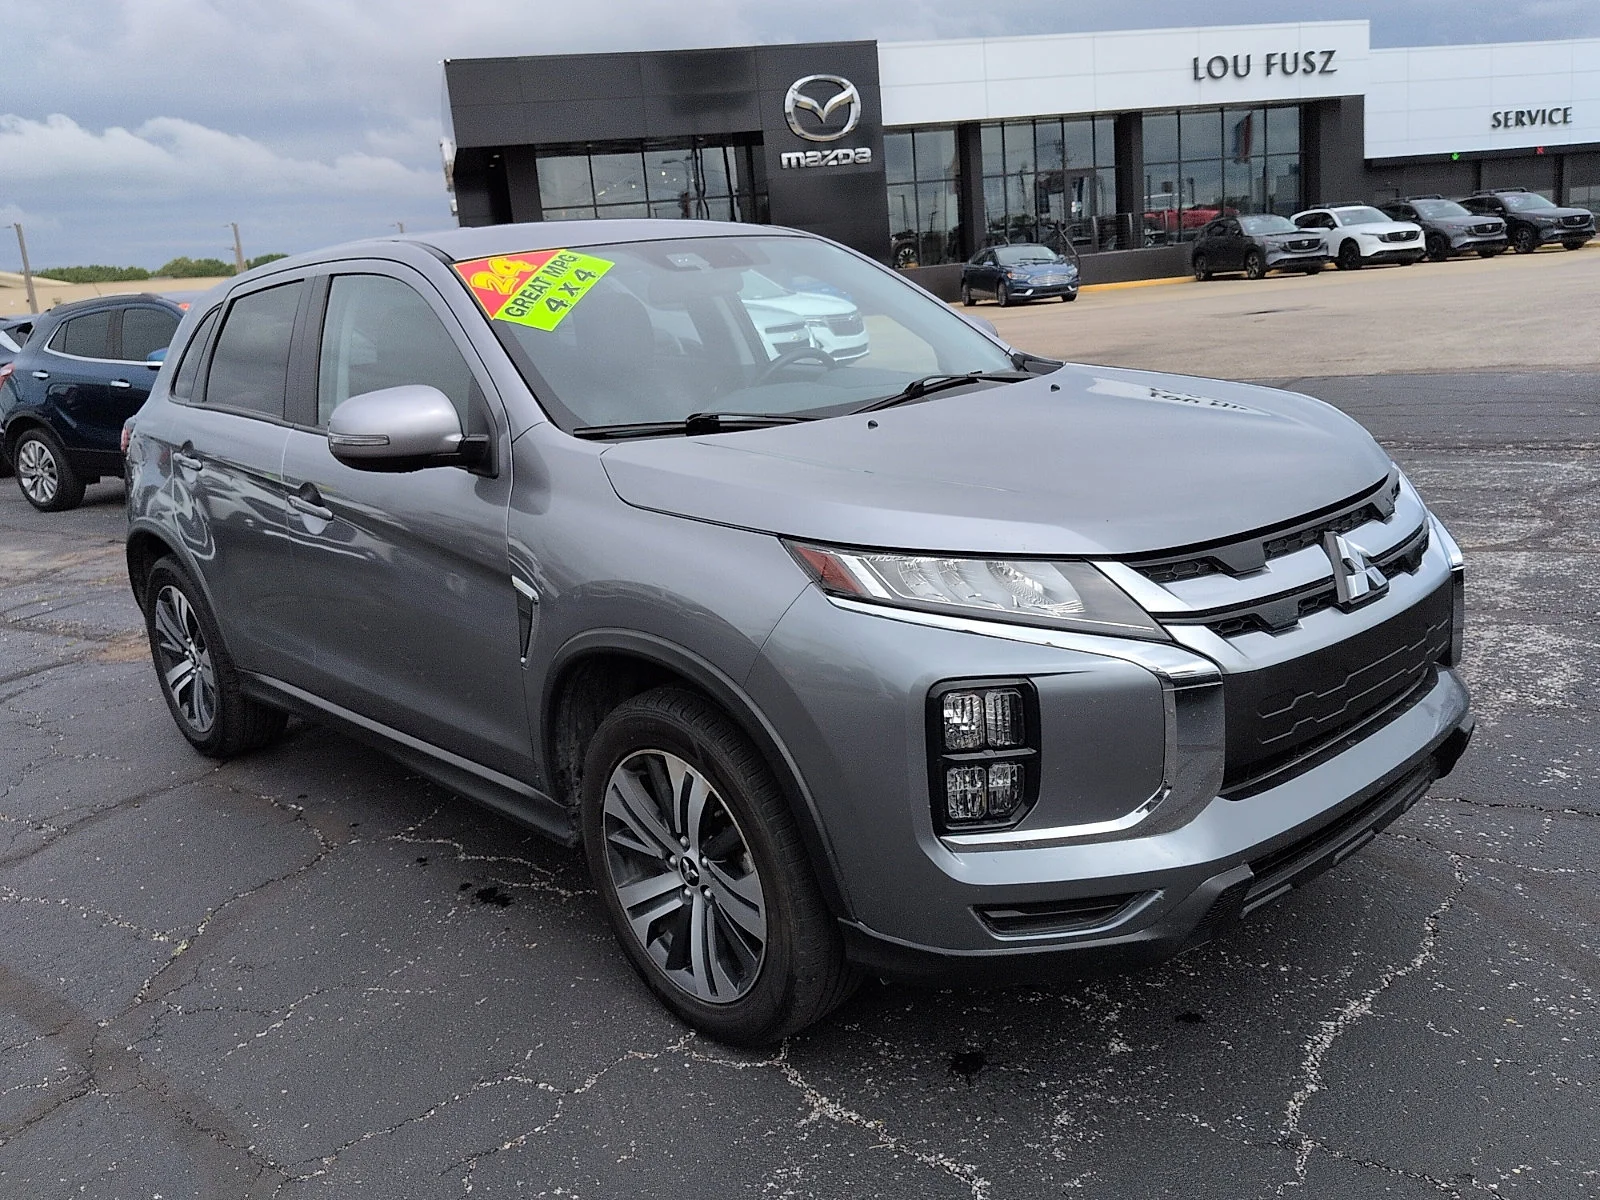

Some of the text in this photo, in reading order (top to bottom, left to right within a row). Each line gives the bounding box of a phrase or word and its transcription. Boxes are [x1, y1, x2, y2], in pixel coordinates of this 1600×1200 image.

[1193, 50, 1337, 80] LOU FUSZ
[1491, 106, 1573, 128] SERVICE
[505, 254, 578, 317] GREAT MPG
